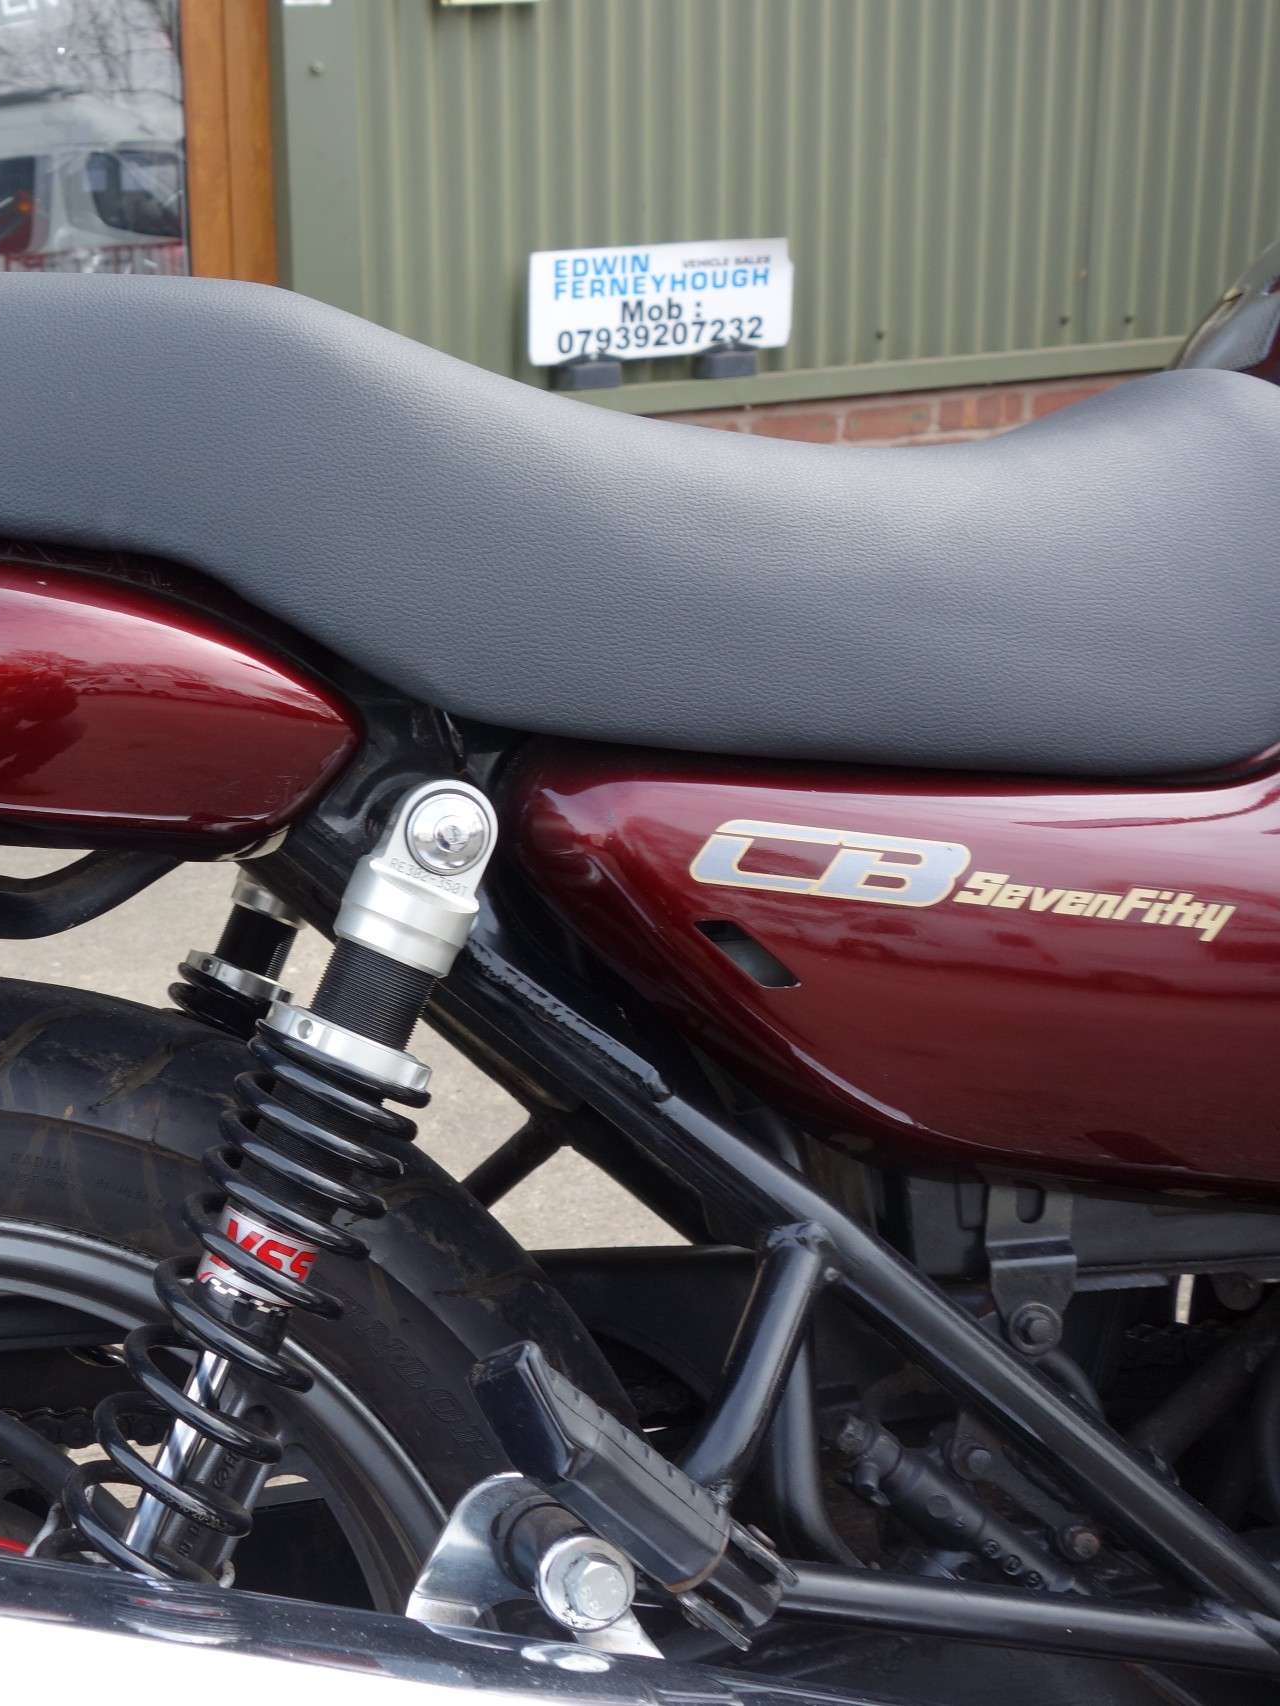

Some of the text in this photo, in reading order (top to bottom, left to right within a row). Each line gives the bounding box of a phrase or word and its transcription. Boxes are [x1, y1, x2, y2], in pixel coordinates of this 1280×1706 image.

[555, 253, 651, 279] EDWIN
[683, 254, 771, 270] VEHICLE SALES
[554, 267, 770, 300] FERNEYHOUGH
[557, 316, 764, 354] 07939207232
[689, 819, 1237, 942] CB SevenFifty
[209, 1218, 318, 1283] YSS
[338, 1290, 498, 1462] UNLOP
